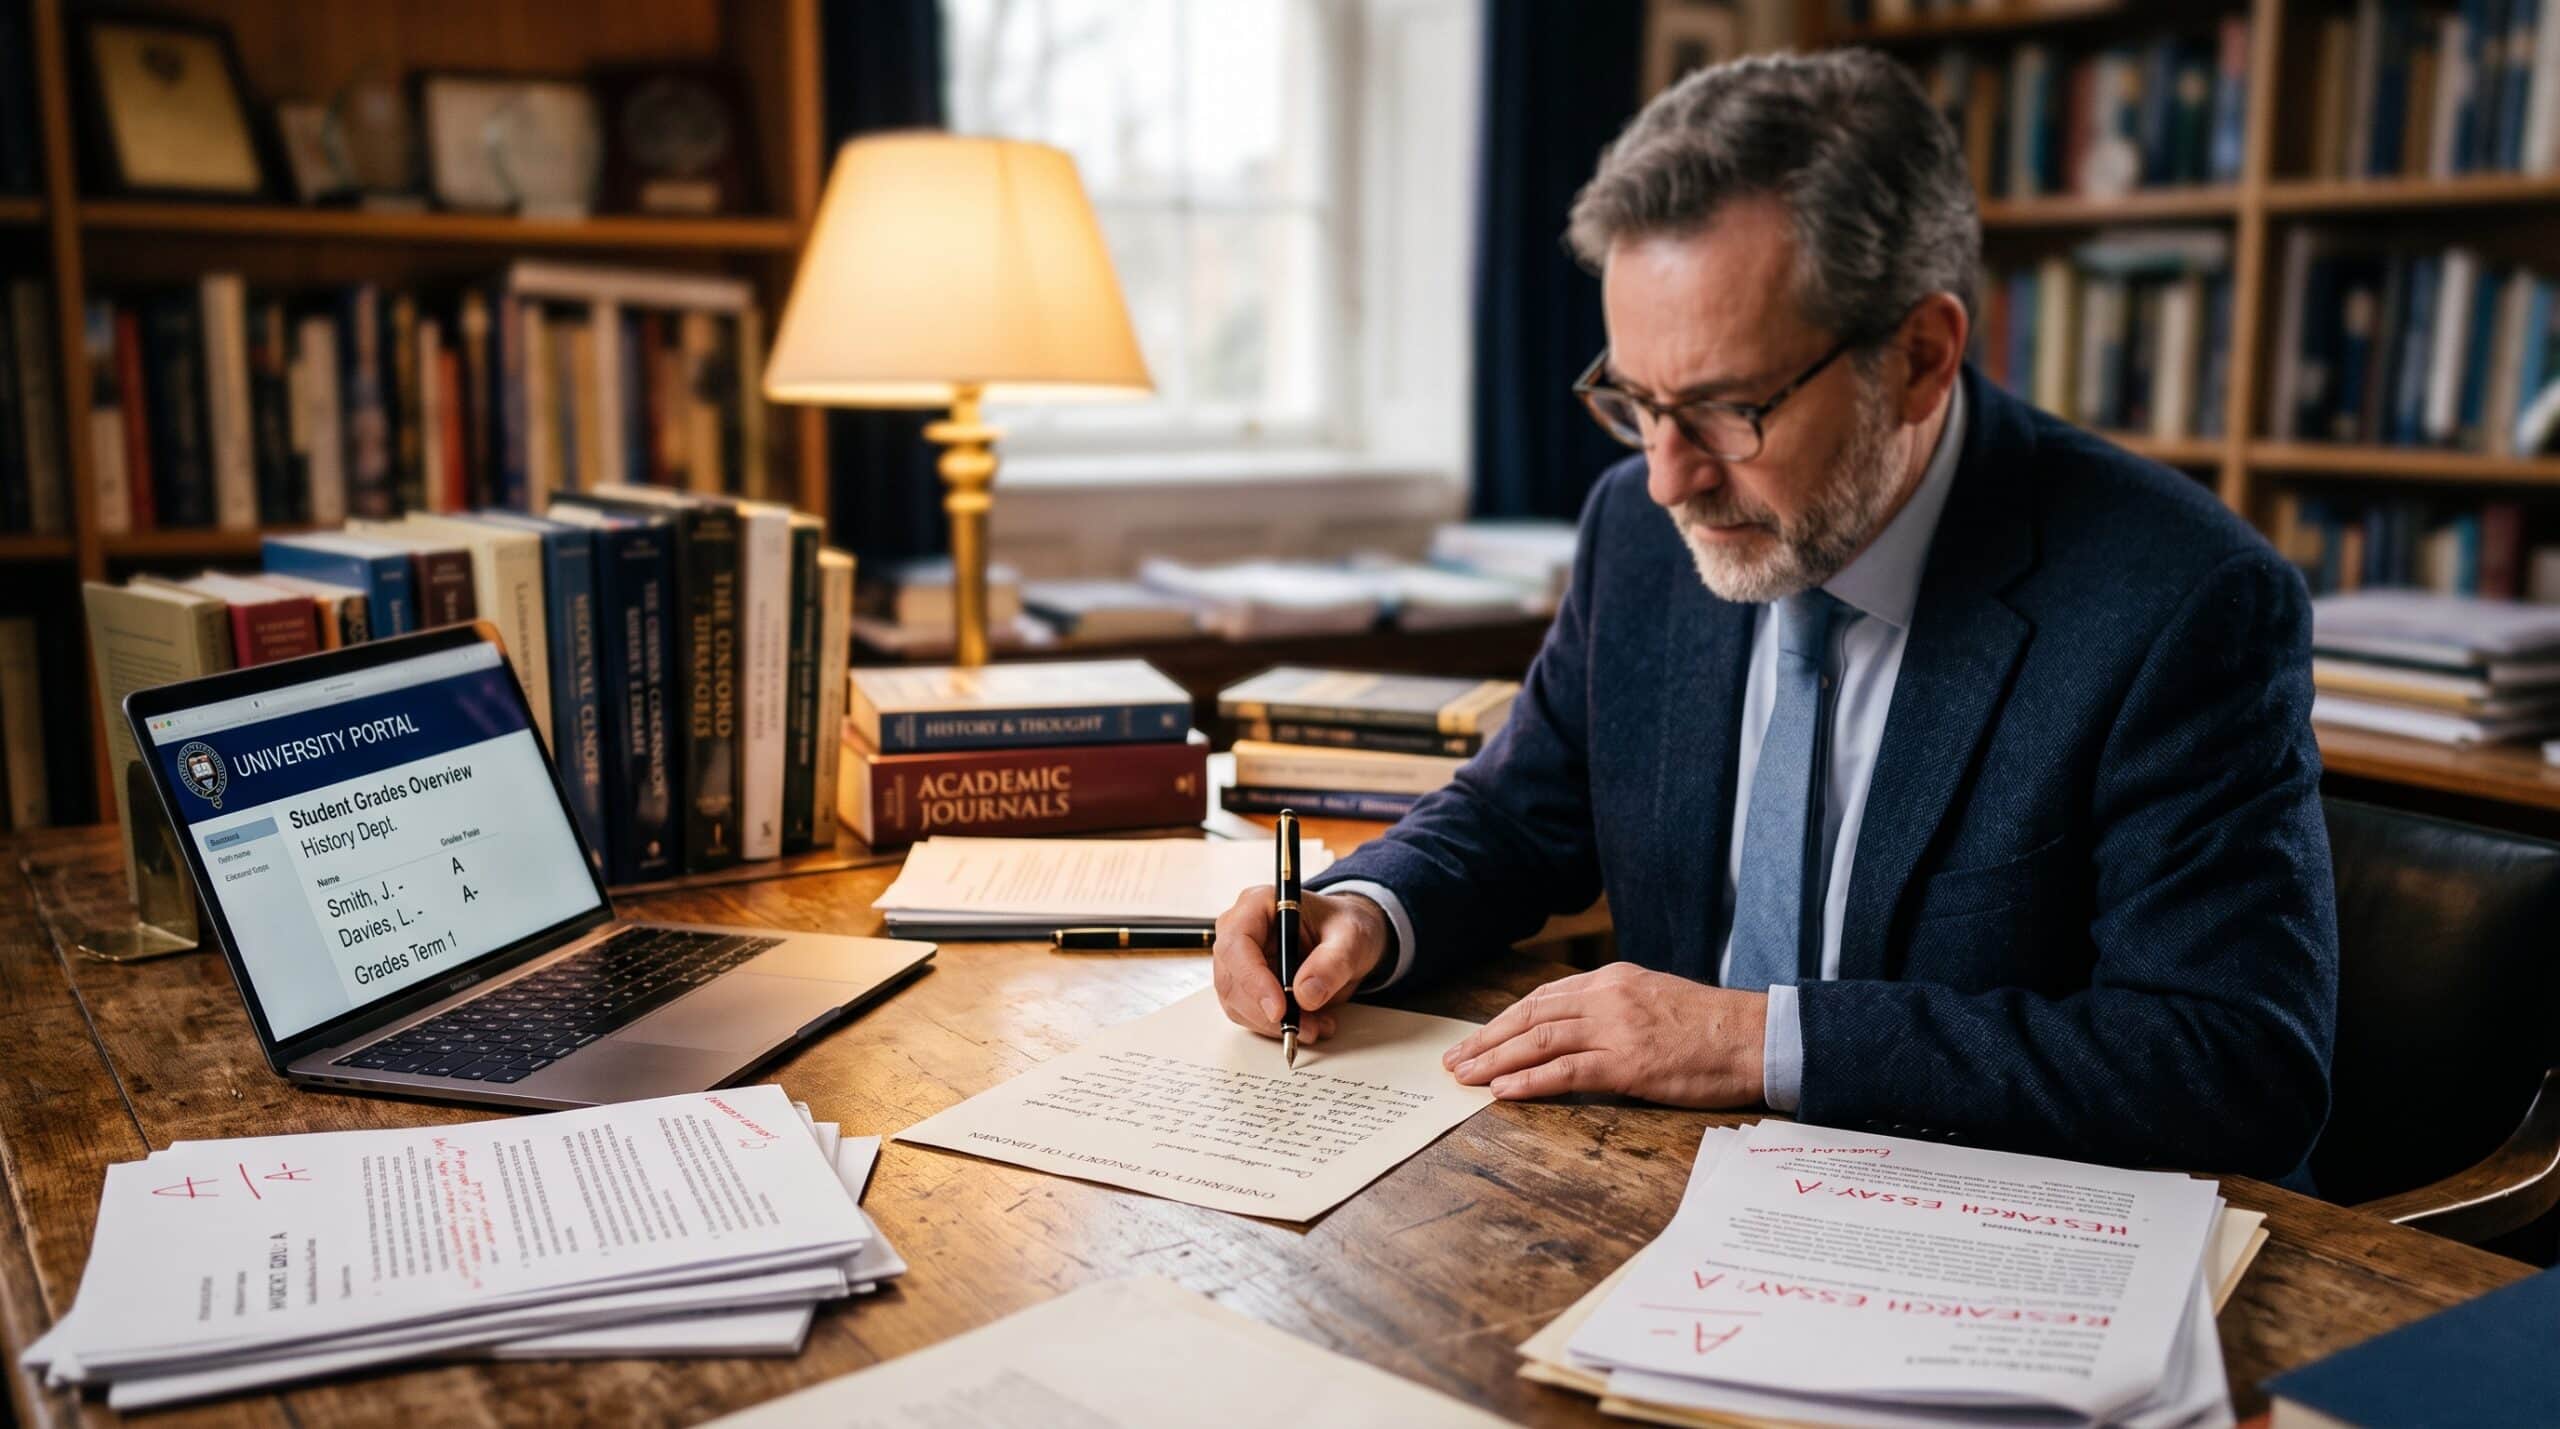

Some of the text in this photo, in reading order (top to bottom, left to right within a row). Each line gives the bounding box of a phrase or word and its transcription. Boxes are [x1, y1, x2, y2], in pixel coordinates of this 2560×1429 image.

[926, 714, 1103, 737] HISTORY & THOUGHT
[232, 729, 347, 777] UNIVERSITY
[350, 713, 419, 748] PORTAL
[289, 763, 473, 829] Student Grades Overview
[919, 765, 1072, 799] ACADEMIC
[920, 794, 1071, 830] JOURNALS
[301, 815, 398, 858] History Dept.
[317, 874, 341, 888] Name
[451, 856, 465, 875] A
[327, 887, 377, 919] Smith,
[381, 880, 397, 901] J.
[462, 885, 479, 903] A-
[338, 914, 398, 949] Davies,
[398, 906, 415, 926] L.
[354, 930, 458, 986] Grades Term 1
[152, 1176, 219, 1199] A
[1794, 1177, 1823, 1195] A
[1694, 1270, 1723, 1292] A
[1888, 1298, 2111, 1328] RESEARCH
